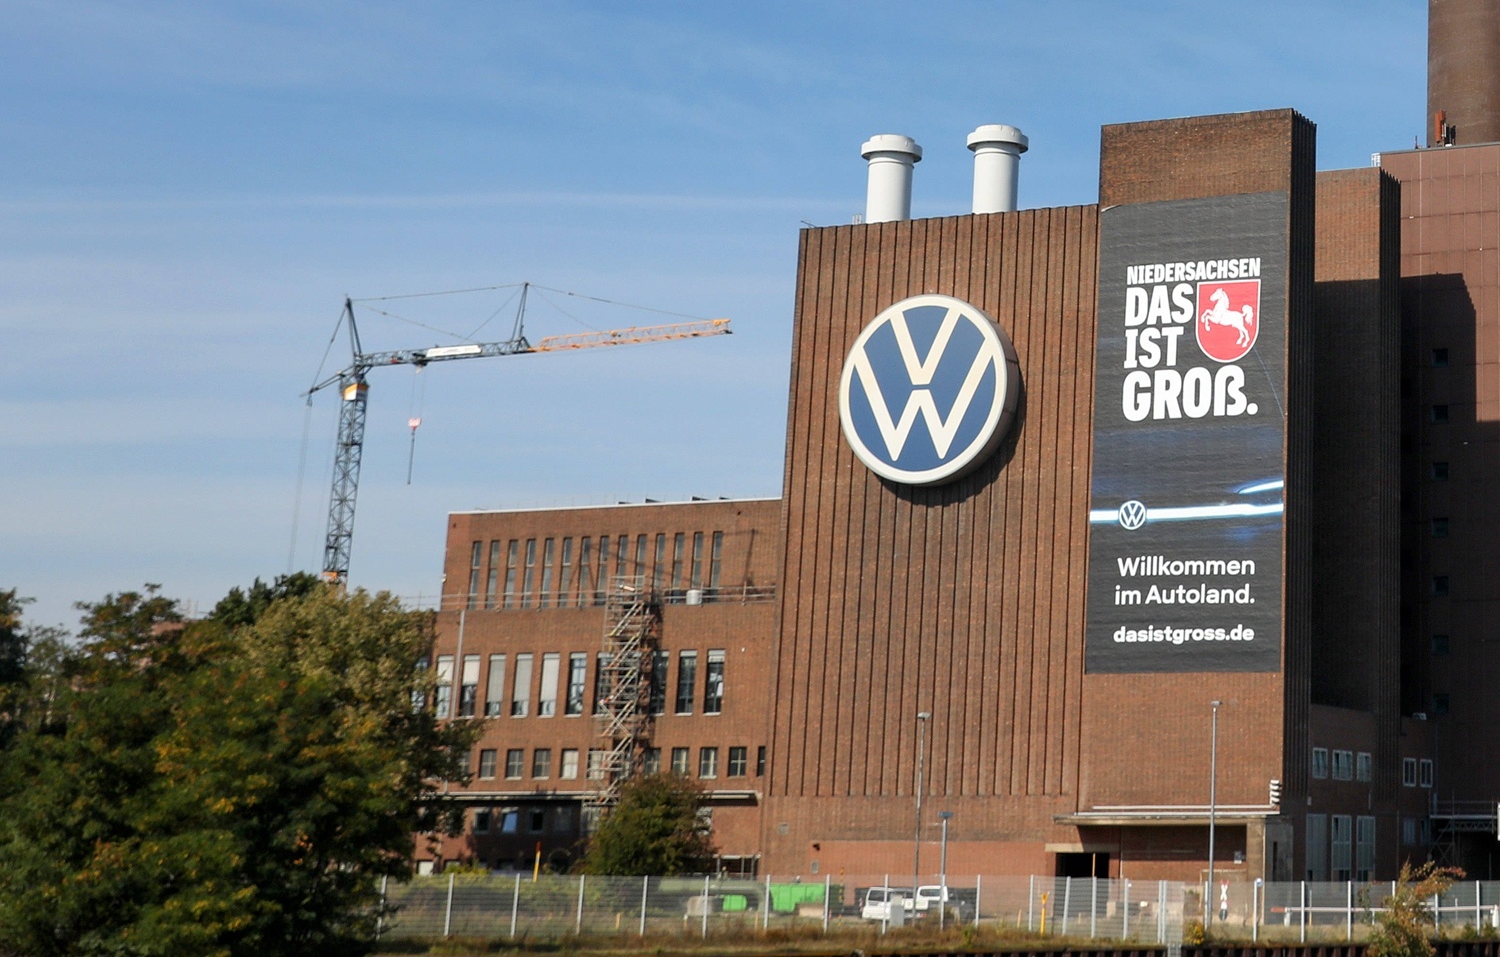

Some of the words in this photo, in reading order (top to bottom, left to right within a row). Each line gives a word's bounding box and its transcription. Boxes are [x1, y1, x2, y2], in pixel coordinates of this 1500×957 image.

[1126, 257, 1261, 284] NIEDERSACHSEN
[1124, 283, 1195, 327] DAS
[1123, 326, 1184, 369] IST
[1117, 555, 1256, 577] Willkommen
[1114, 585, 1142, 606] im
[1144, 583, 1256, 605] Autoland.
[1113, 624, 1255, 646] dasistgross.de
